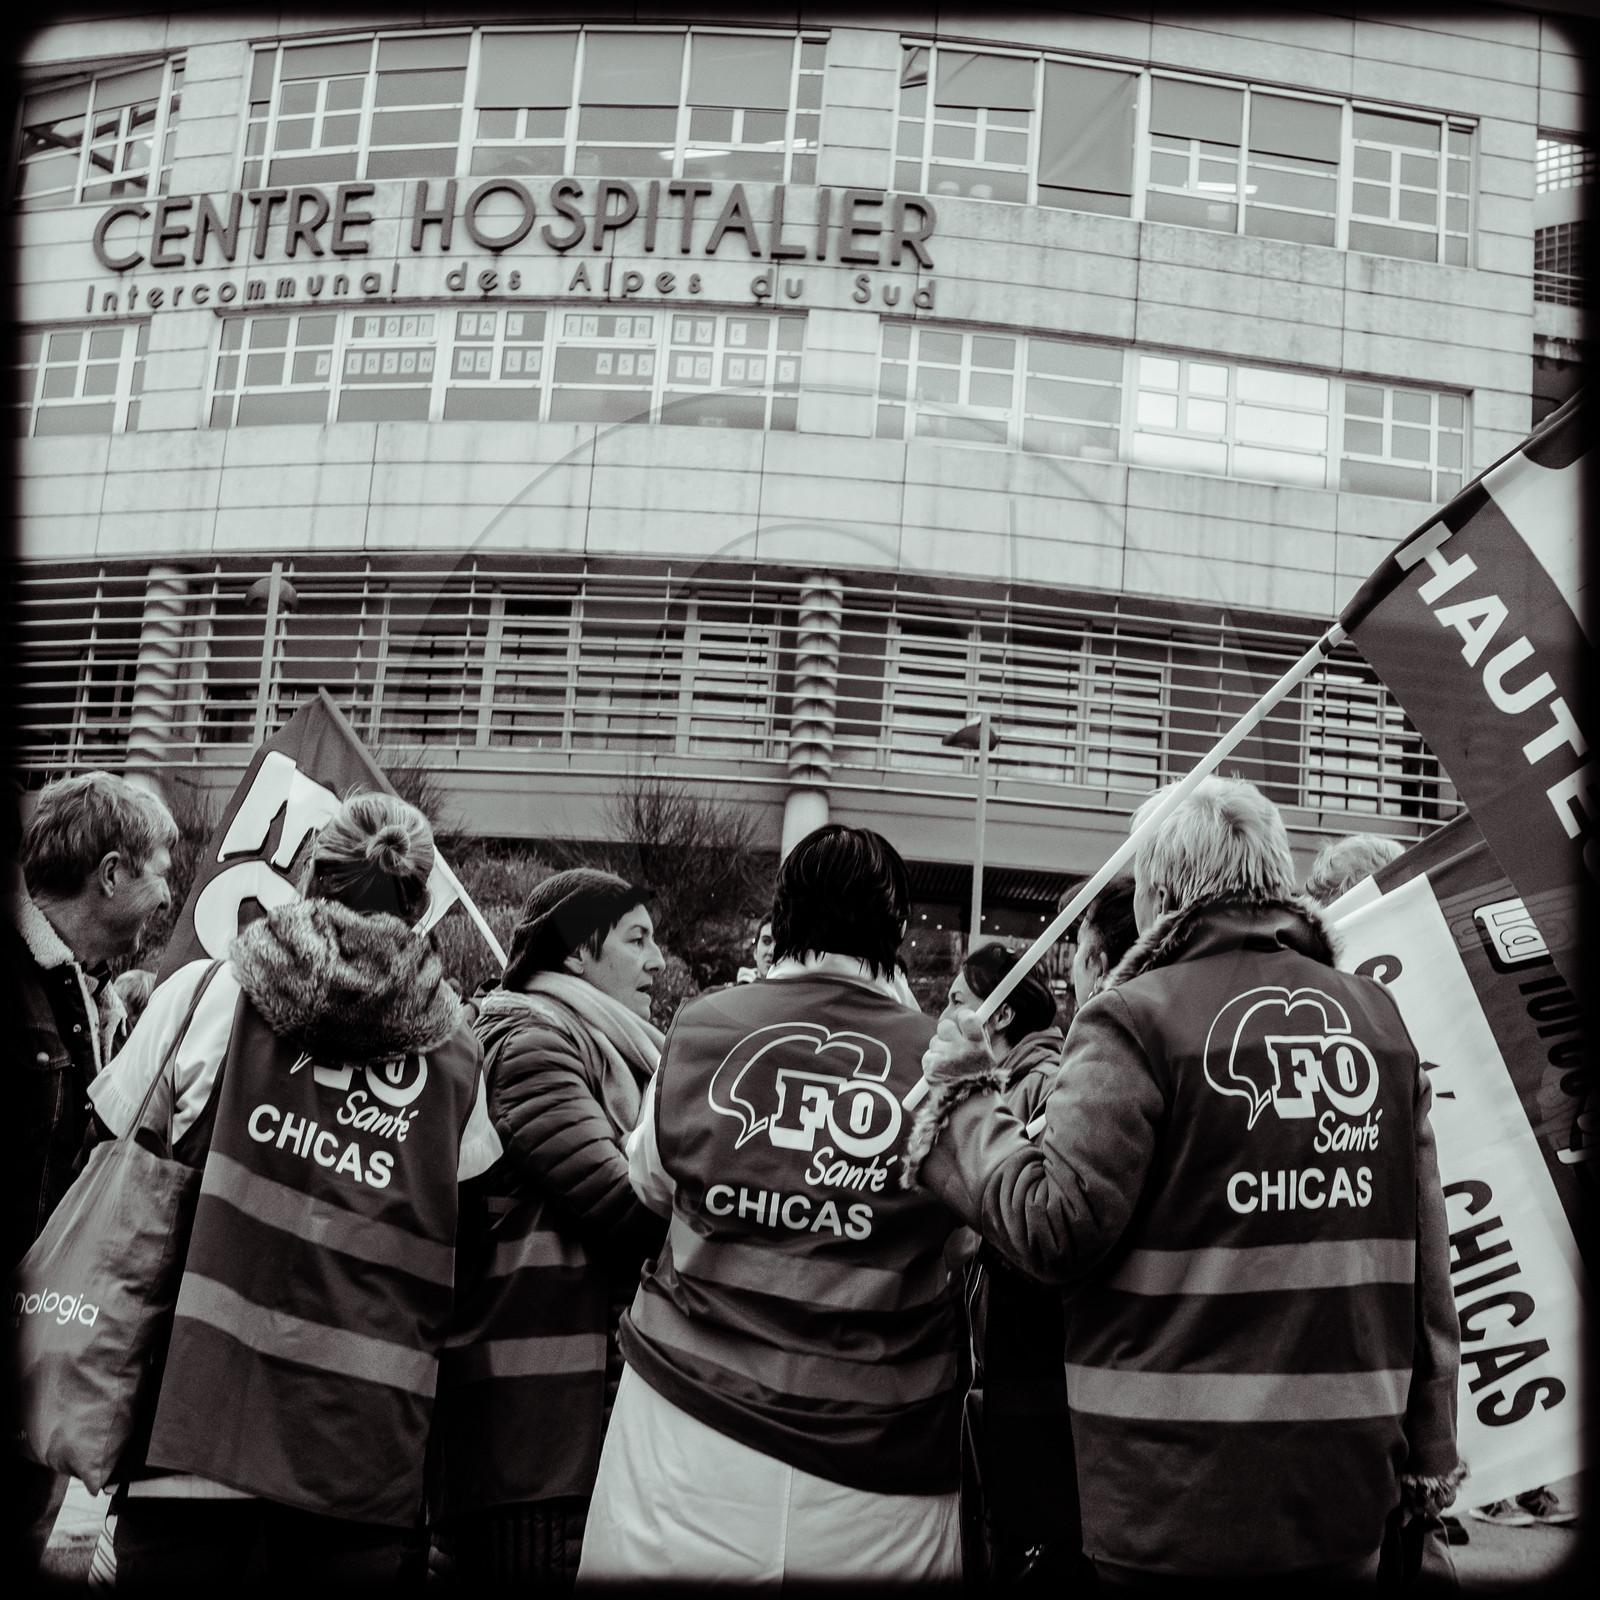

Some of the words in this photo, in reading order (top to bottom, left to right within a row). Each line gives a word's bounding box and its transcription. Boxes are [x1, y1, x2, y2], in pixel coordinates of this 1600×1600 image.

[93, 182, 376, 271] CENTRE
[410, 178, 938, 269] HOSPITALIER
[86, 262, 400, 312] Intercommunal
[445, 262, 522, 292] des
[568, 261, 702, 299] Alpes
[750, 268, 804, 299] du
[853, 274, 937, 310] Sud
[1265, 1034, 1379, 1120] FO
[336, 1089, 419, 1143] Santé
[769, 1068, 902, 1158] FO
[1313, 1108, 1383, 1154] Santé
[247, 1103, 395, 1189] CHICAS
[804, 1145, 899, 1193] Santé
[705, 1184, 874, 1241] CHICAS
[1227, 1166, 1373, 1214] CHICAS
[1441, 1179, 1567, 1427] CHICAS
